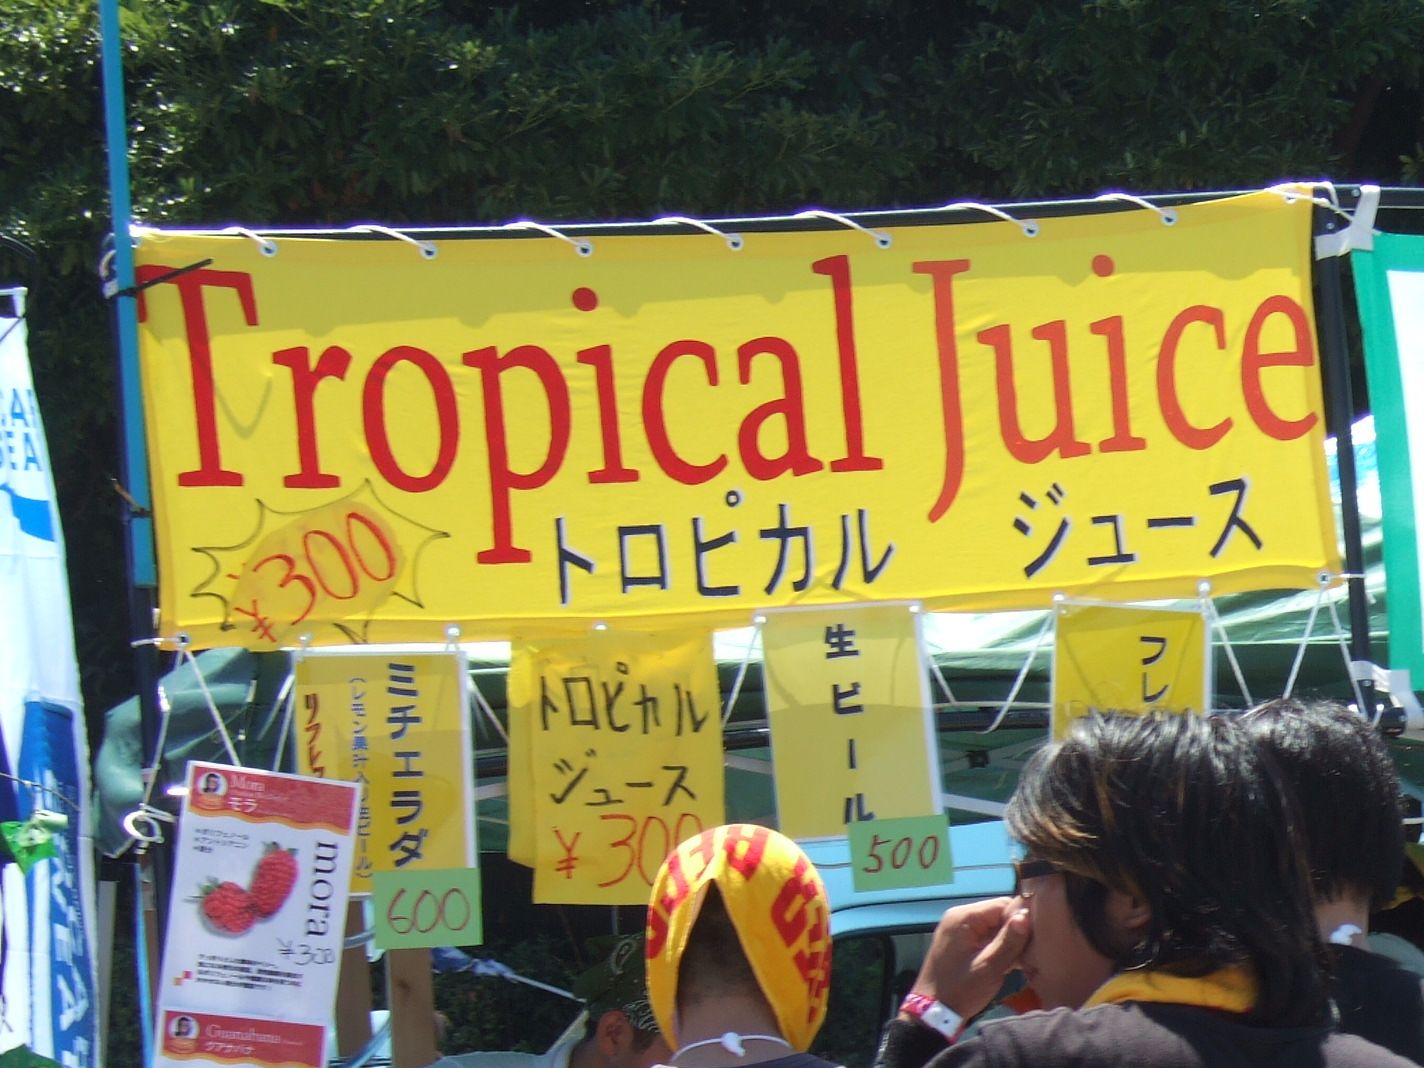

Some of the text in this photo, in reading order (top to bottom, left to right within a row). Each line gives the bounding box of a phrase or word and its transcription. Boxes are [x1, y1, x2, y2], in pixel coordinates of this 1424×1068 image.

[137, 253, 1318, 564] Tropical Juice
[233, 511, 398, 644] ¥300
[555, 476, 1263, 604] トロピカル ジュース
[539, 660, 709, 737] トロピカル
[824, 624, 876, 825] 生ビール
[549, 748, 698, 807] ジュース
[306, 841, 339, 938] mora
[863, 834, 940, 874] 500
[387, 887, 471, 934] 600
